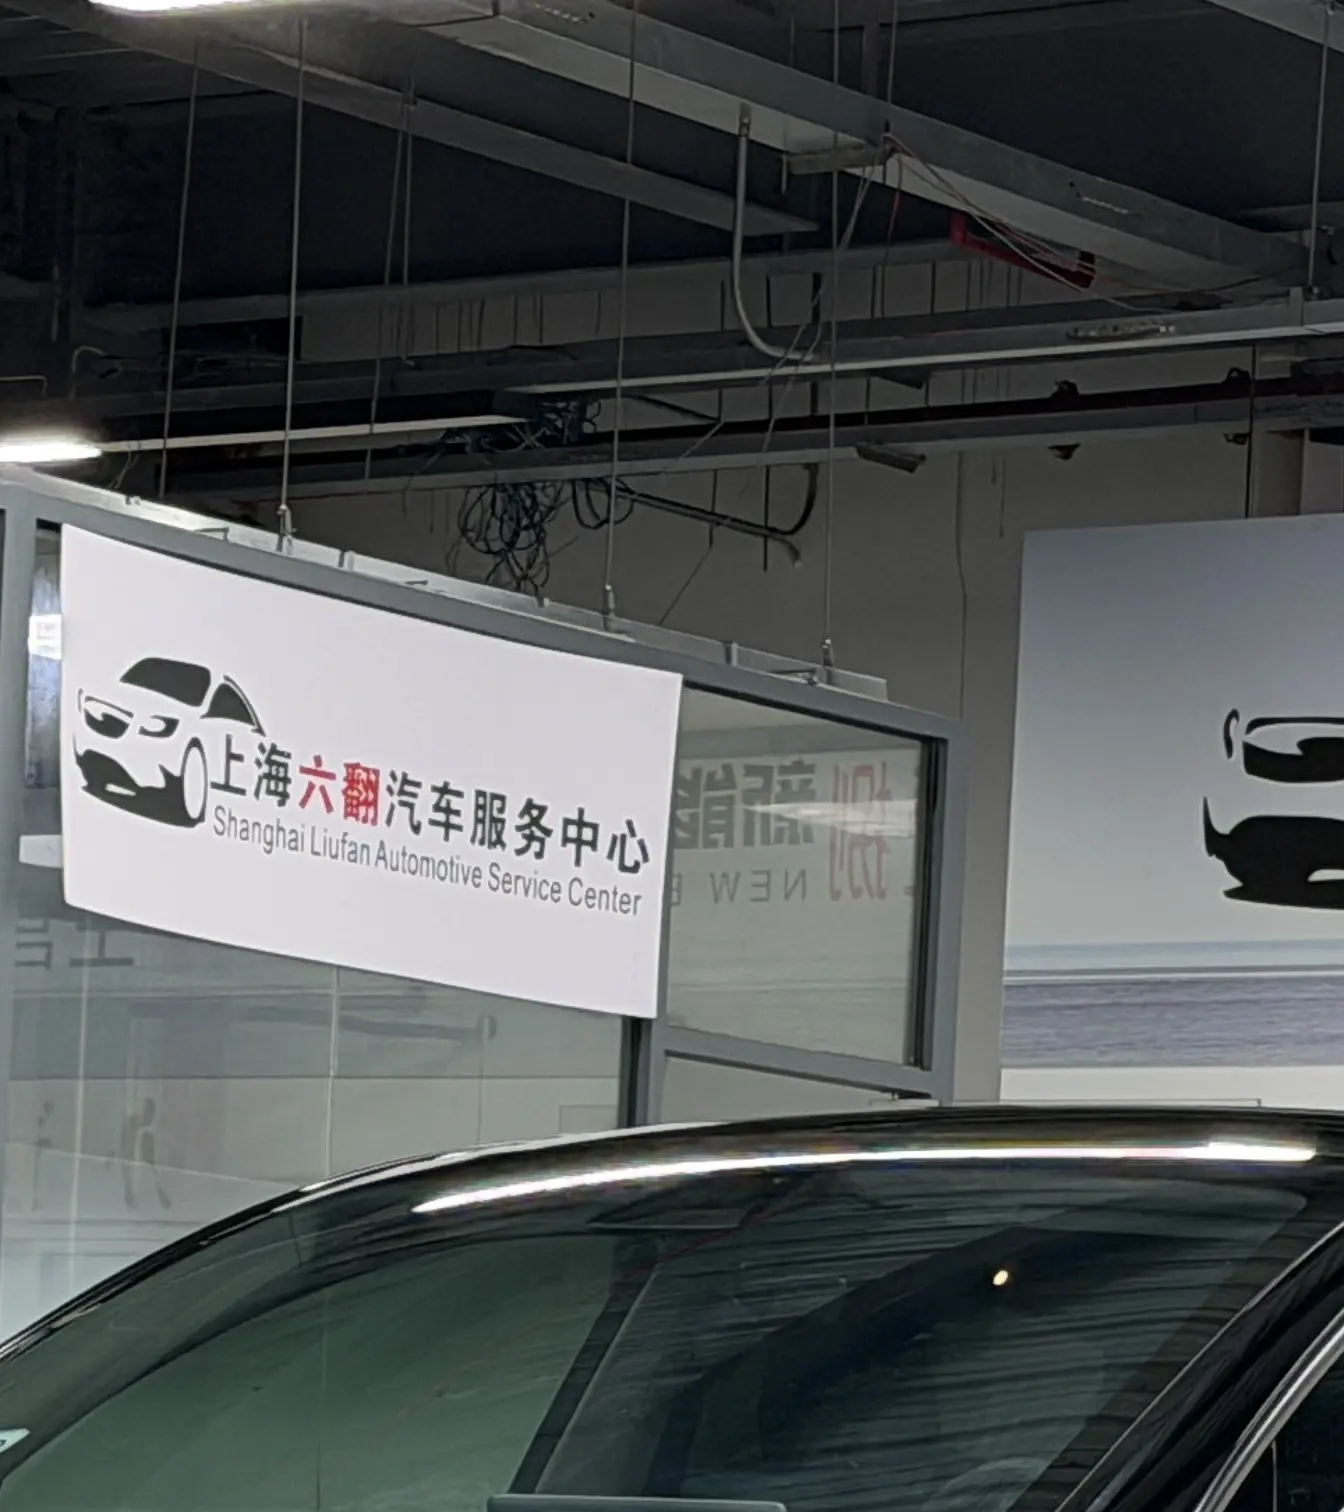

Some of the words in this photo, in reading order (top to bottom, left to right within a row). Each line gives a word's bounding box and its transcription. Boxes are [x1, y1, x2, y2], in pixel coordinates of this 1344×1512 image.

[209, 732, 652, 876] 上海六翻汽车服务中心
[212, 803, 306, 856] Shanghai
[309, 827, 371, 867] Liufan
[374, 841, 484, 890] Automotive
[488, 861, 563, 904] Service
[567, 876, 643, 917] Center
